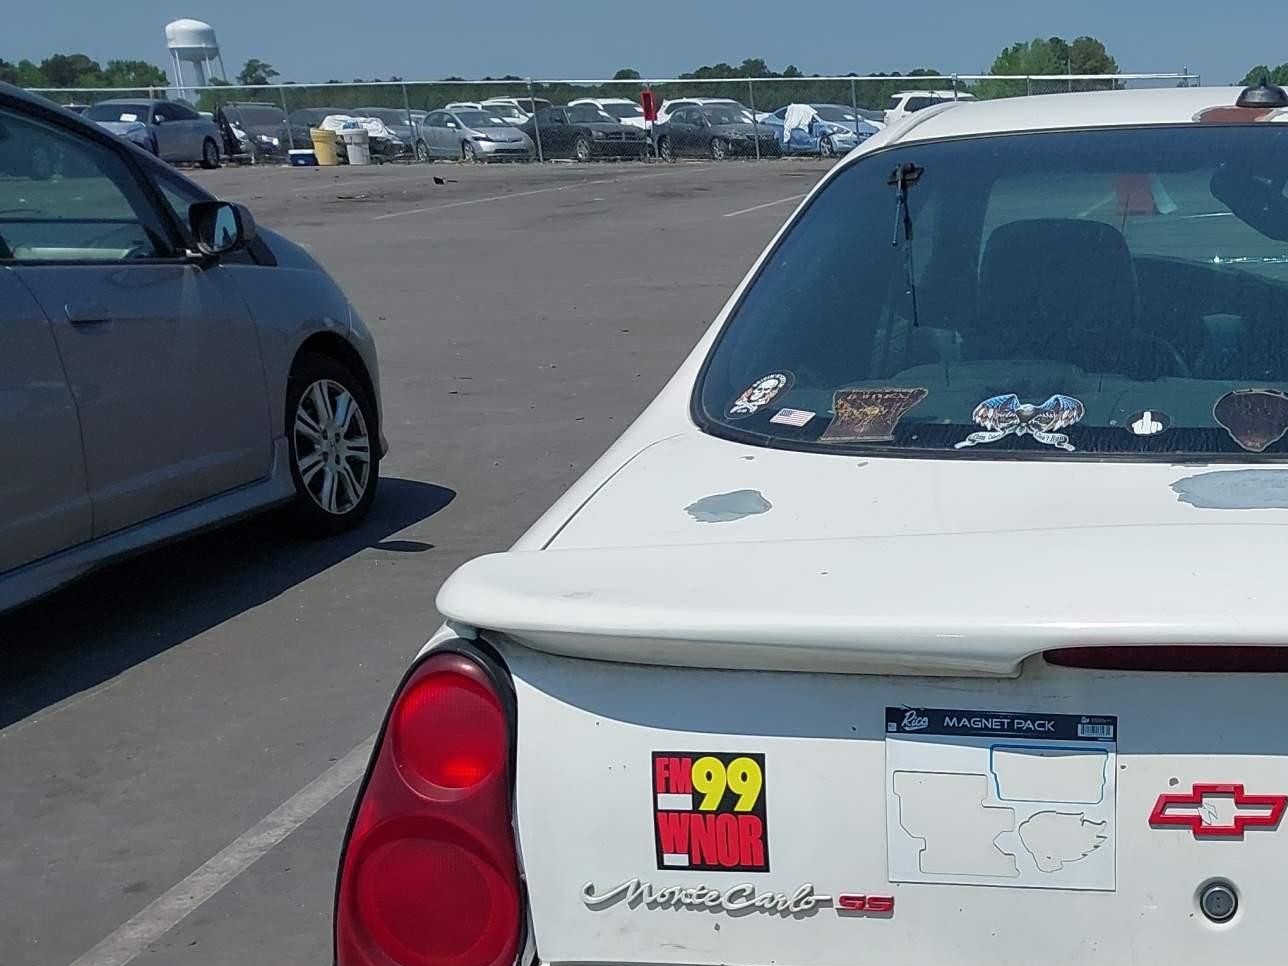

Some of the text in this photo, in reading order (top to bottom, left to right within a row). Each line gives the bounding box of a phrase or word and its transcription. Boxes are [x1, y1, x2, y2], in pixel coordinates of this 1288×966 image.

[944, 716, 1055, 732] MAGNET PACK
[655, 756, 763, 812] FM 99
[656, 812, 765, 867] WNOR
[836, 893, 895, 913] SS
